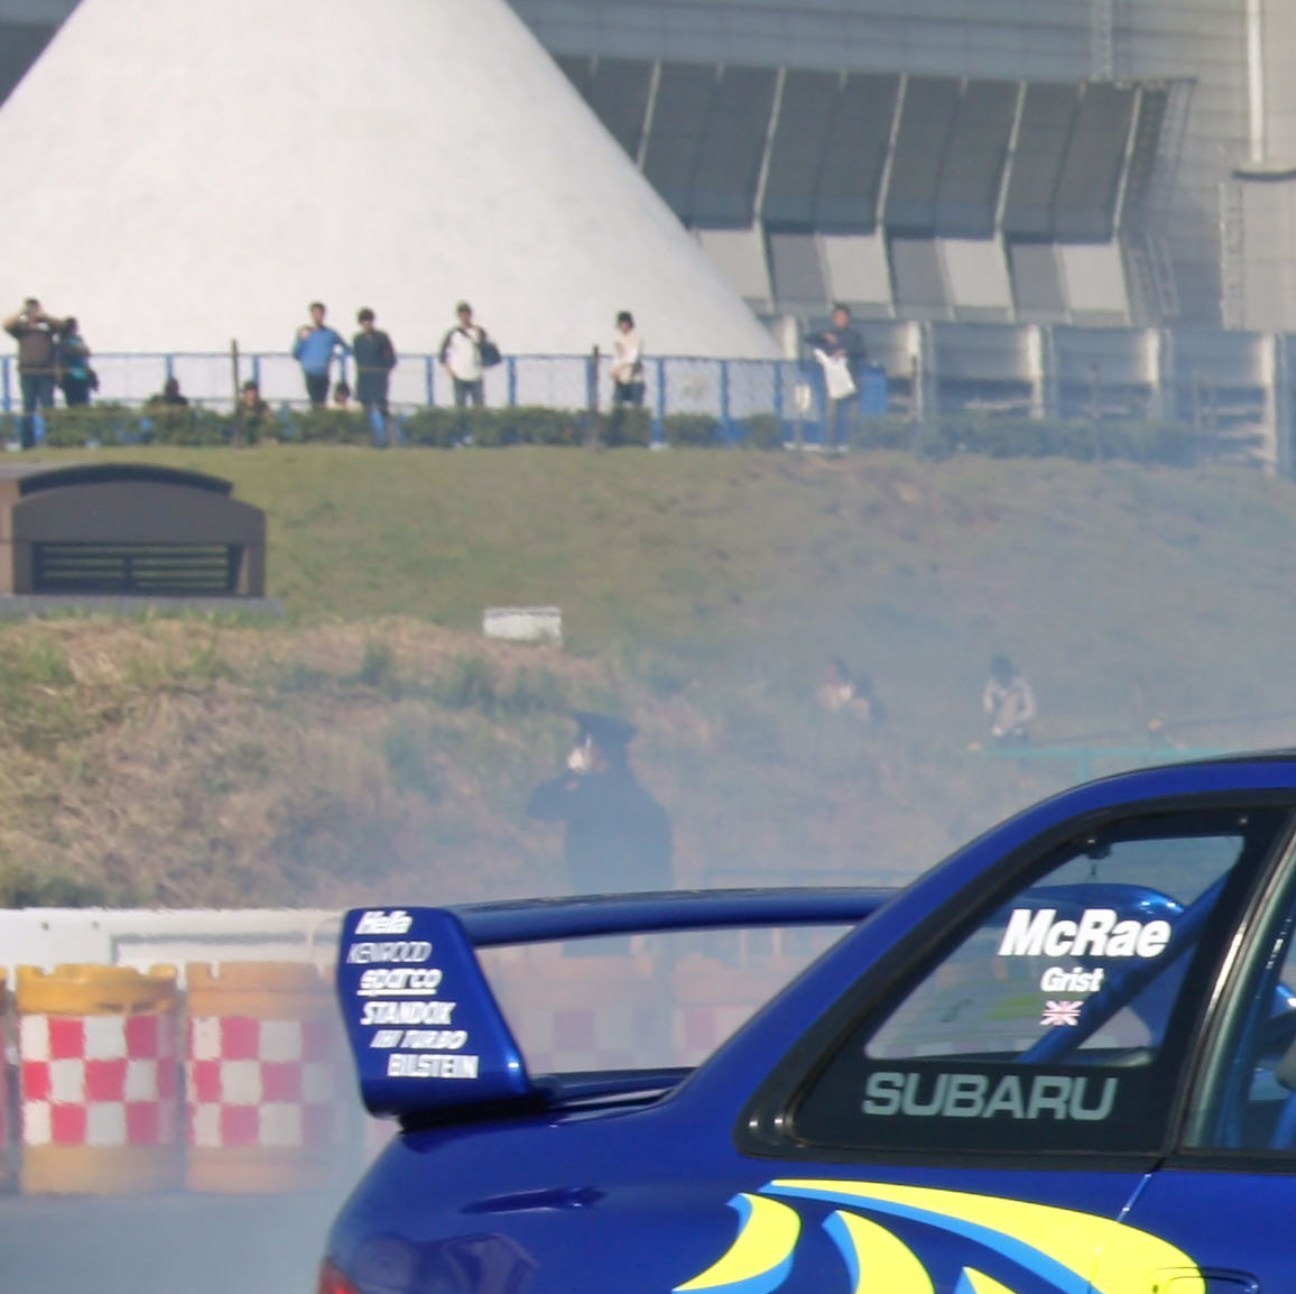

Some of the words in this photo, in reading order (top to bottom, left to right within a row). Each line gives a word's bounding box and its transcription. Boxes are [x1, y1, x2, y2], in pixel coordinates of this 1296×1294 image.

[355, 910, 413, 935] Hella
[998, 908, 1172, 958] McRae
[346, 941, 433, 964] KENWOOD
[1040, 966, 1105, 993] Grist
[387, 1052, 479, 1080] BILSTEIN
[862, 1071, 1119, 1121] SUBARU
